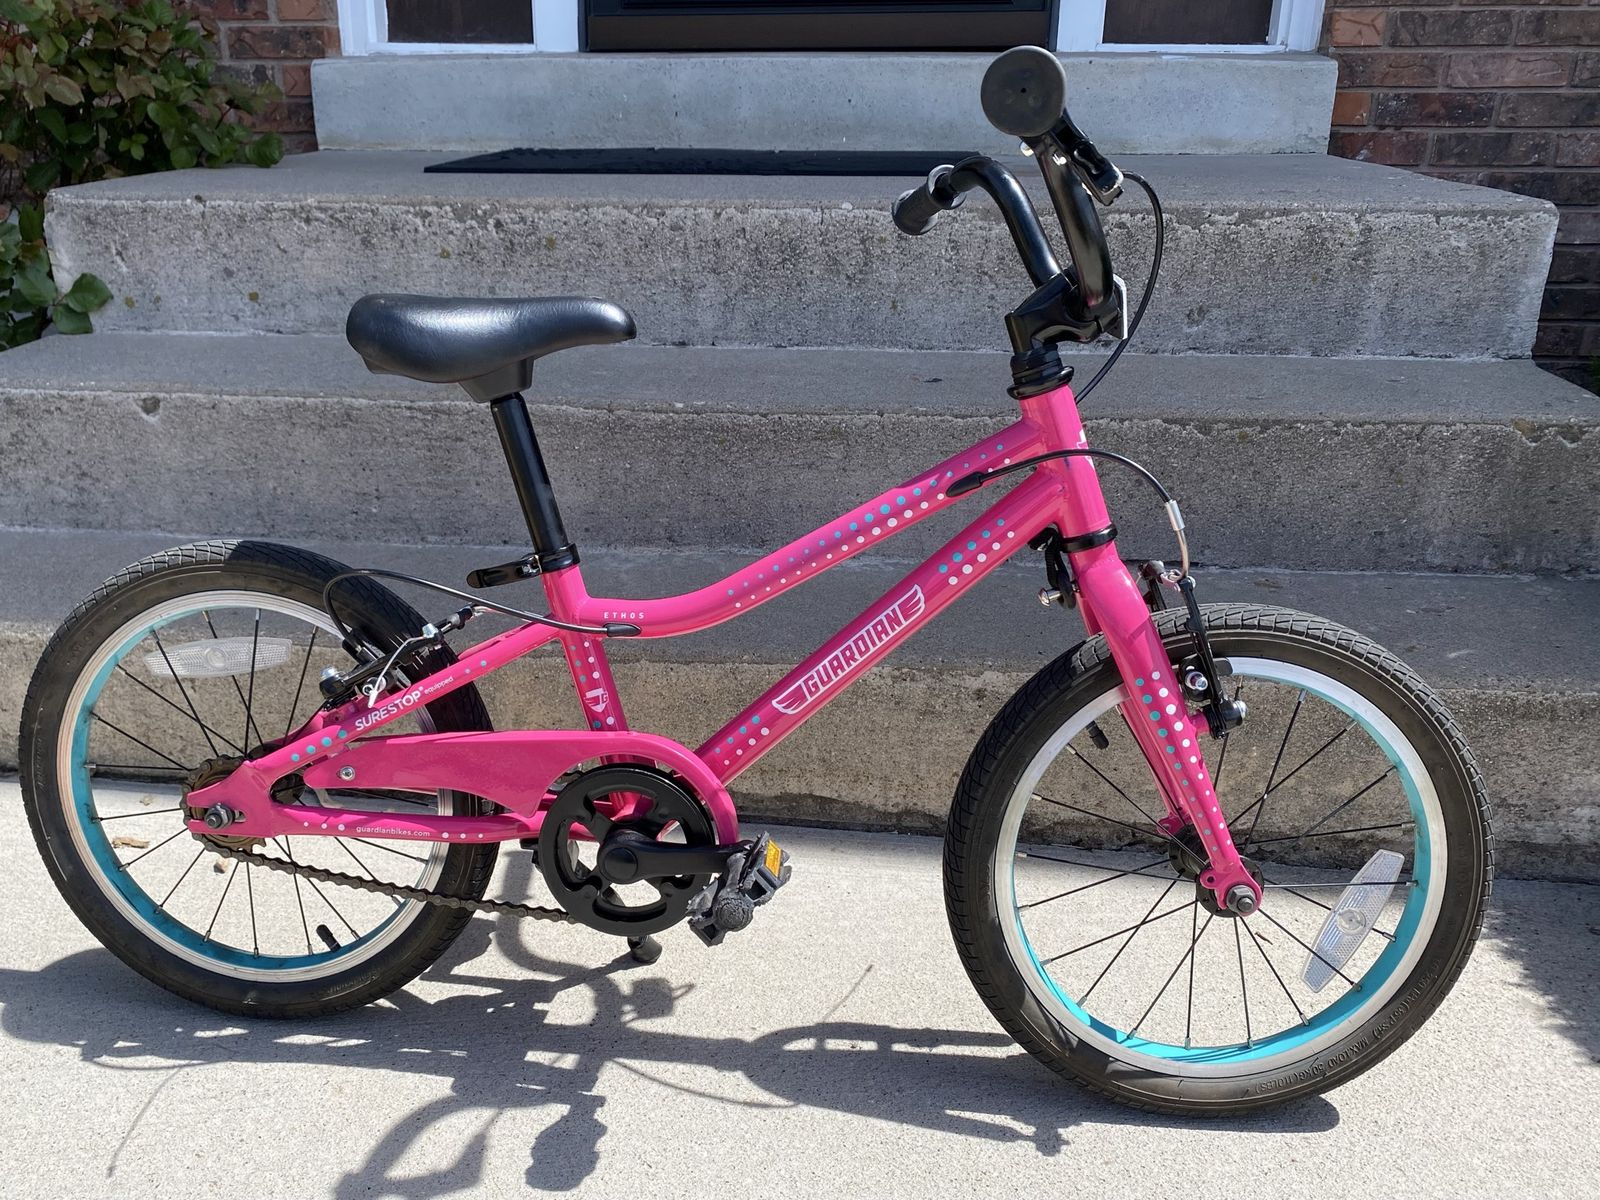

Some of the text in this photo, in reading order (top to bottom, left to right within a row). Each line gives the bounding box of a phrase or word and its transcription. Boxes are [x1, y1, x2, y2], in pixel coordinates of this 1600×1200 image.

[603, 611, 645, 619] ETHOS
[800, 602, 908, 700] GUARDIAN
[424, 675, 454, 695] equipped
[356, 825, 431, 837] guardianbikes.com
